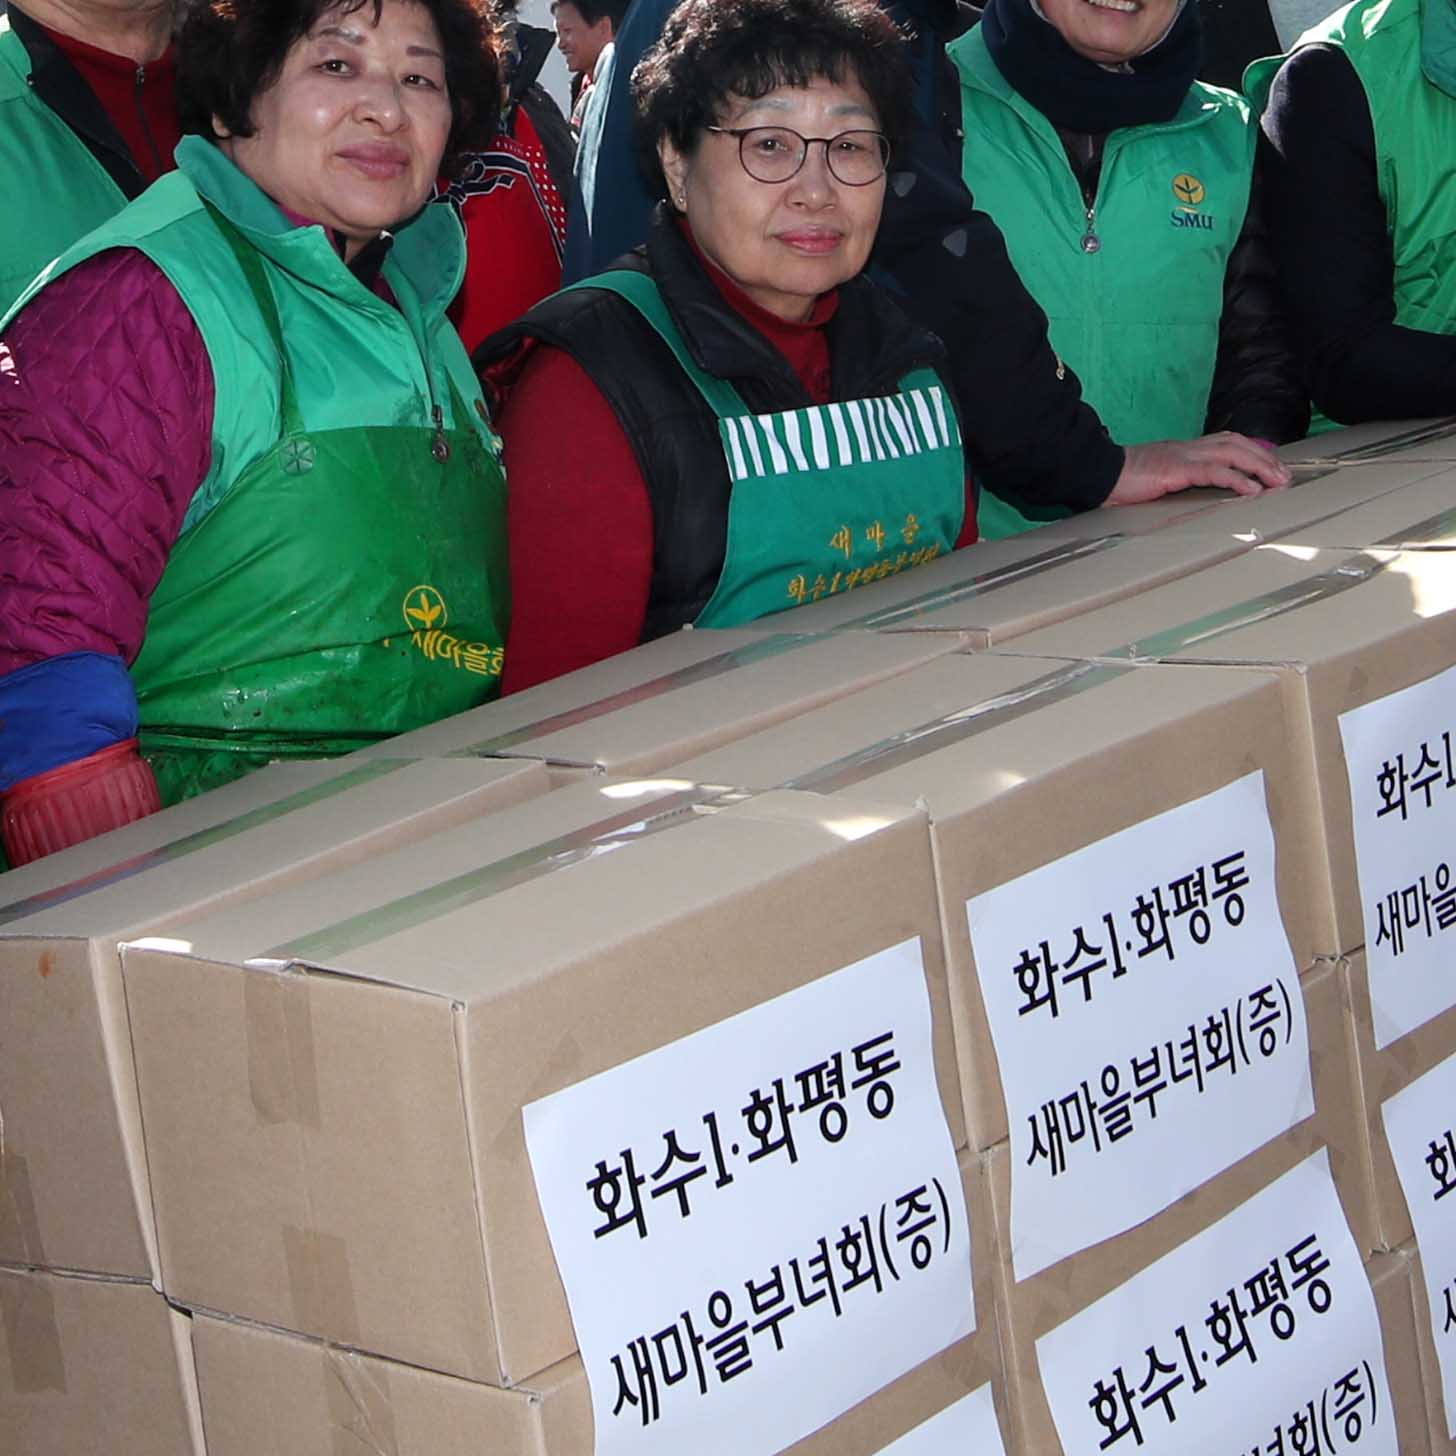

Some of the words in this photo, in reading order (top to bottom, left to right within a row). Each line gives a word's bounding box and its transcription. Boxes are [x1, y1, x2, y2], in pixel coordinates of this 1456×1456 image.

[1170, 211, 1214, 230] SMU
[1027, 979, 1291, 1176] 새마을부녀회(증)
[610, 1178, 950, 1426] 새마을부녀회(증)
